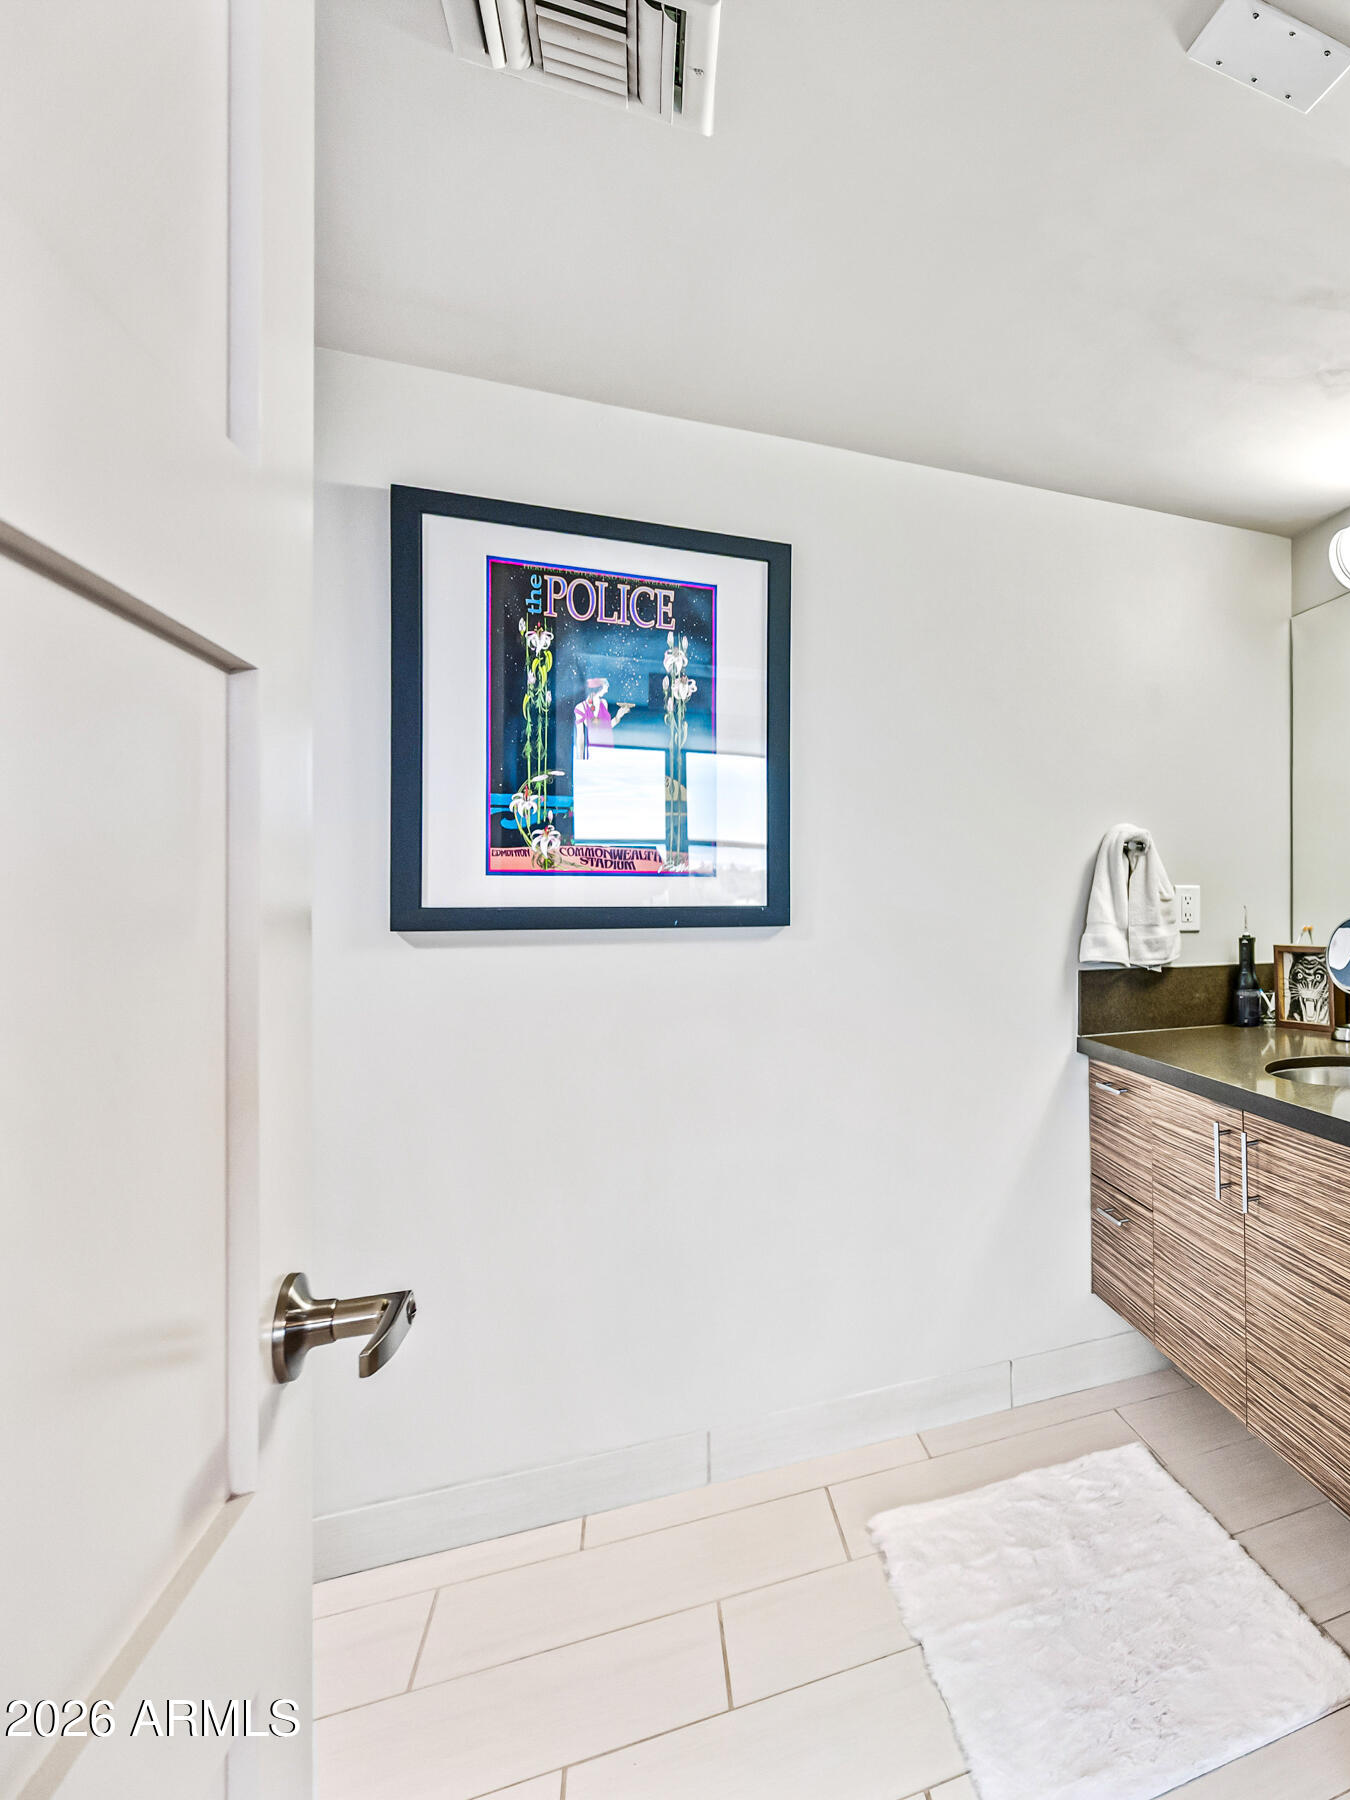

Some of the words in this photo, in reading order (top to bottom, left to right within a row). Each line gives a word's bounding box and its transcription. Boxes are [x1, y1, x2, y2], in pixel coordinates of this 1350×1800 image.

[525, 573, 543, 615] the
[543, 574, 676, 631] POLICE
[579, 857, 637, 871] STADIUM
